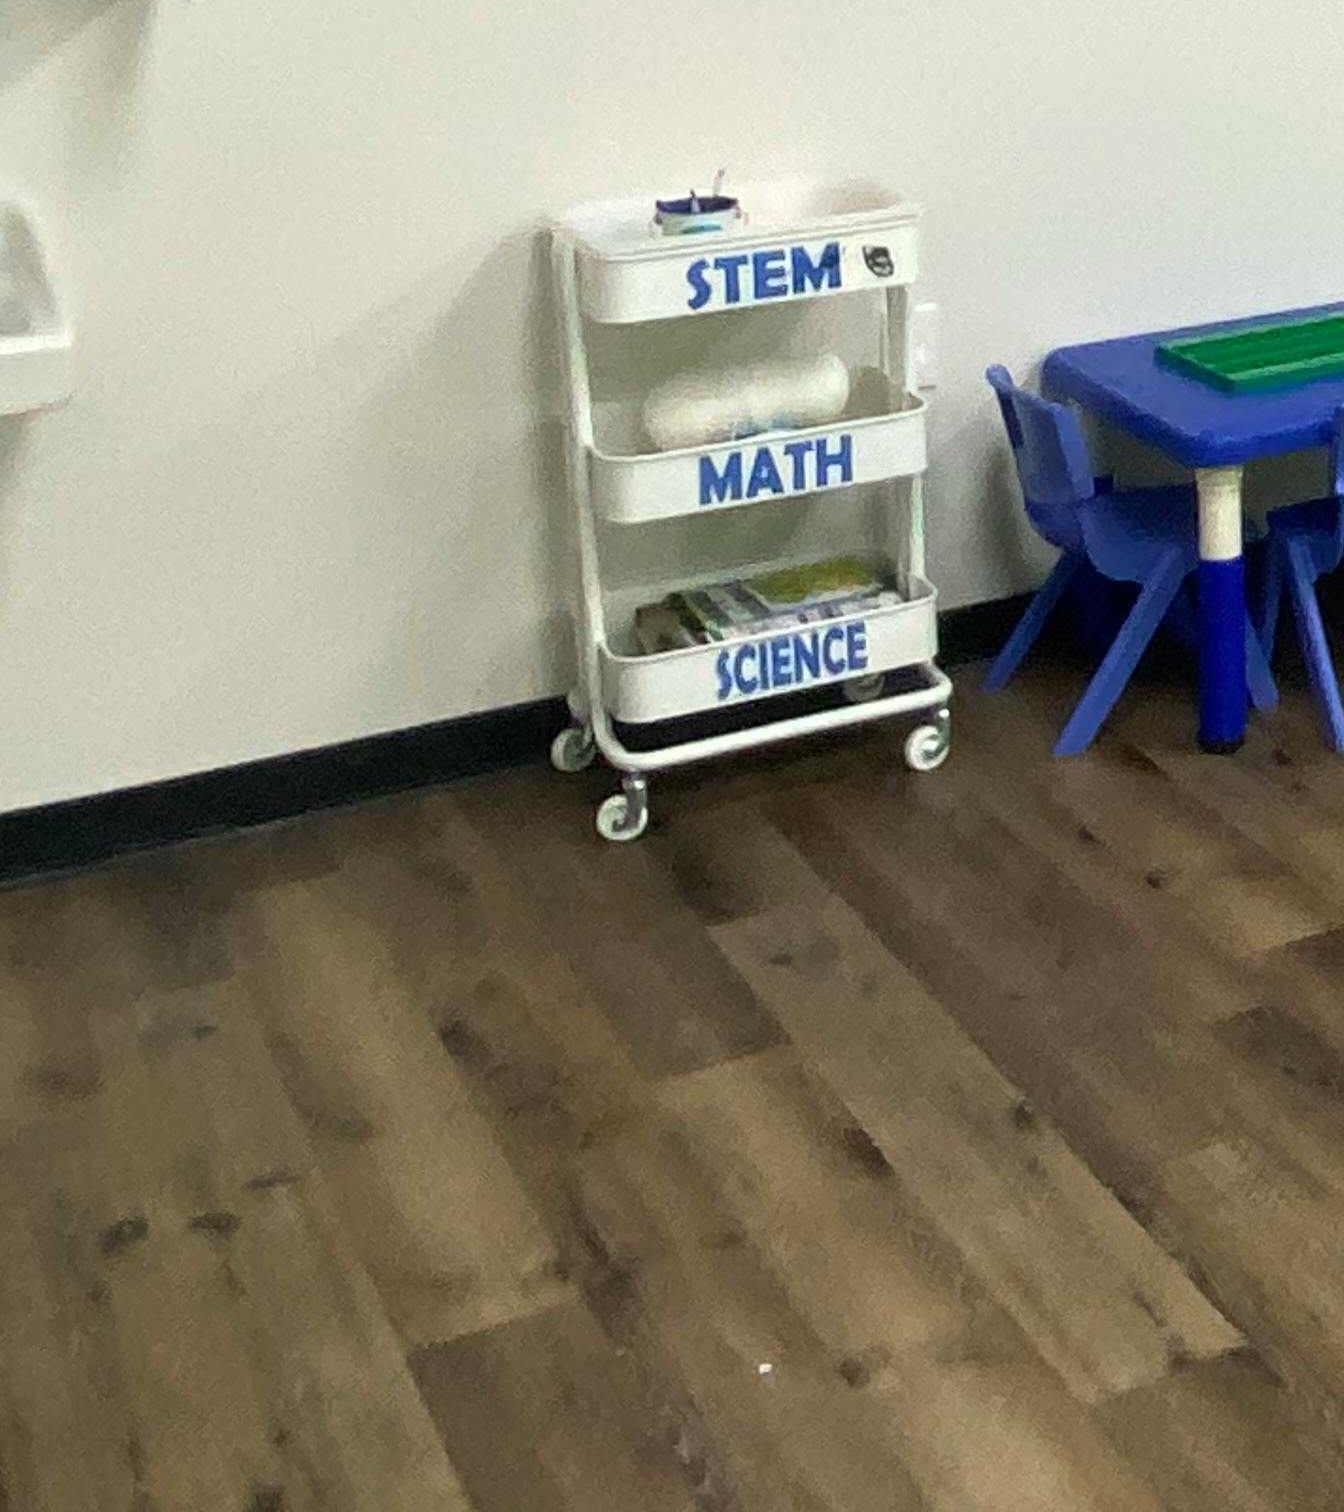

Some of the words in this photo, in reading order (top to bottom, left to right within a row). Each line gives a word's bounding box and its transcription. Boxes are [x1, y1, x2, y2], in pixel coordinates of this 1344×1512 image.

[686, 241, 843, 312] STEM
[699, 435, 854, 506] MATH
[715, 621, 868, 701] SCIENCE
